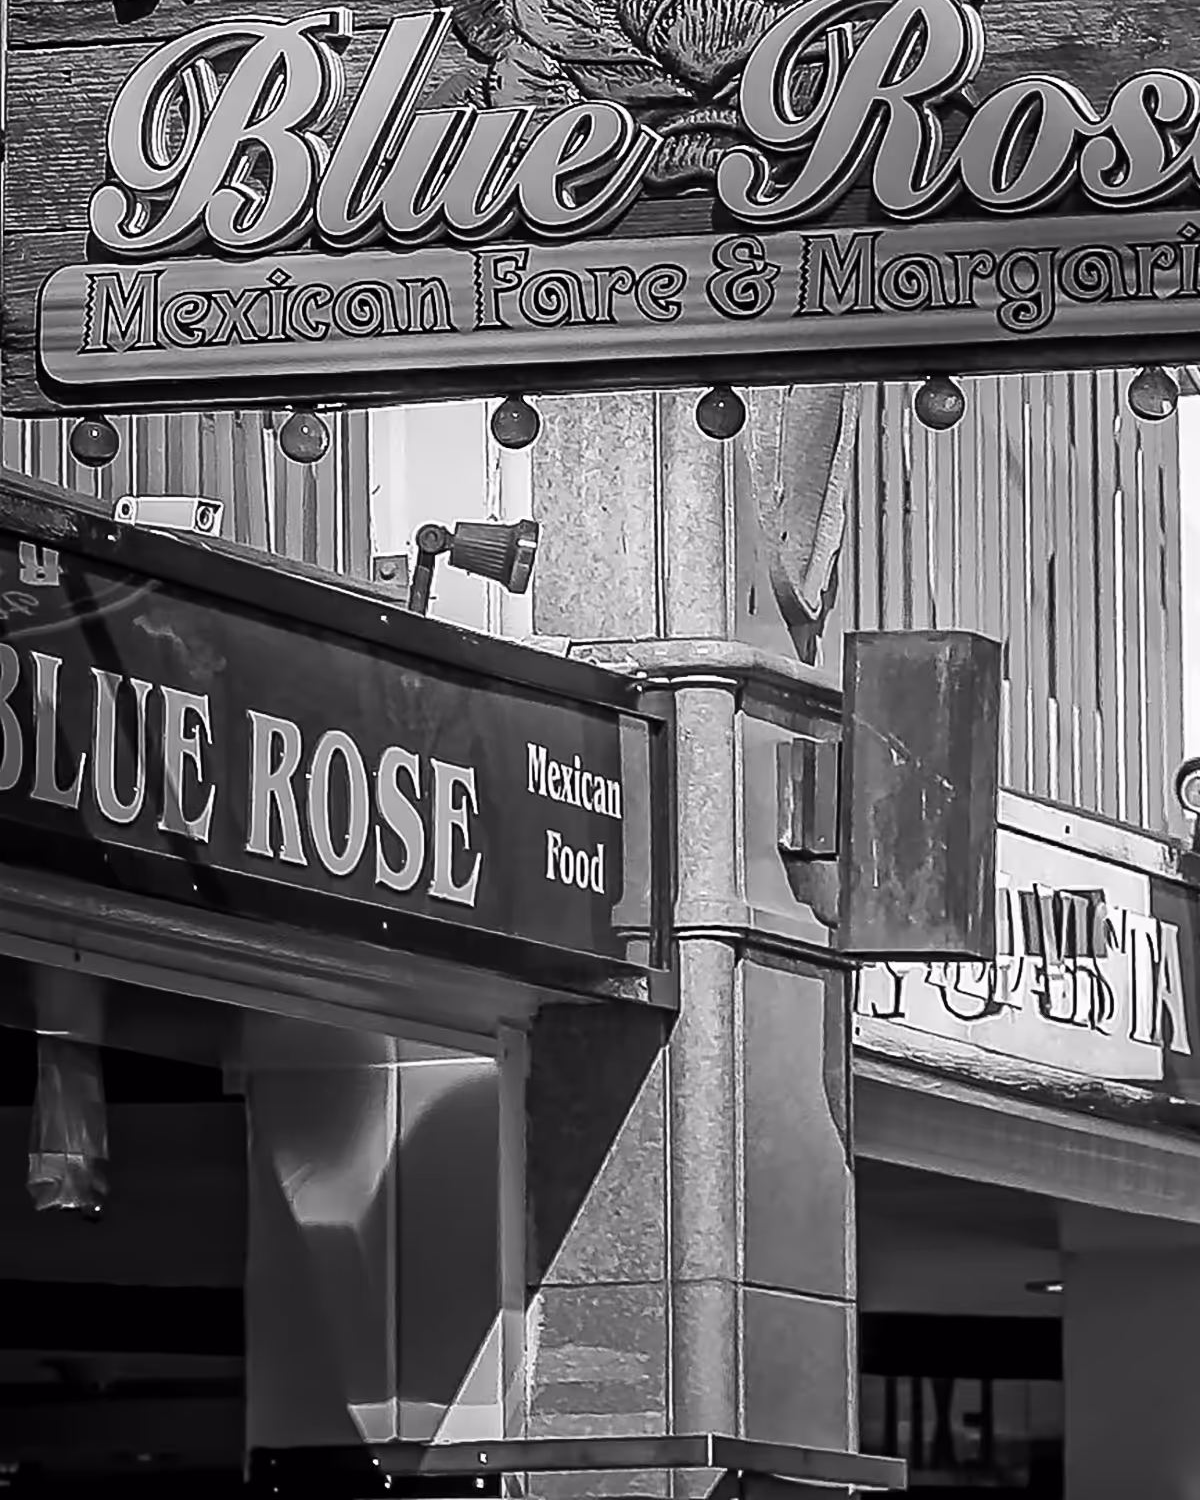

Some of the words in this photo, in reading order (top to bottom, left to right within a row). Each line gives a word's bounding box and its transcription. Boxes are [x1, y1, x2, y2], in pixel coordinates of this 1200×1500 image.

[87, 7, 664, 258] Blue
[77, 266, 456, 356] Mexican
[469, 246, 688, 331] Fare
[711, 235, 781, 323] &
[245, 708, 483, 907] ROSE
[526, 742, 622, 819] Mexican
[545, 829, 605, 894] Food
